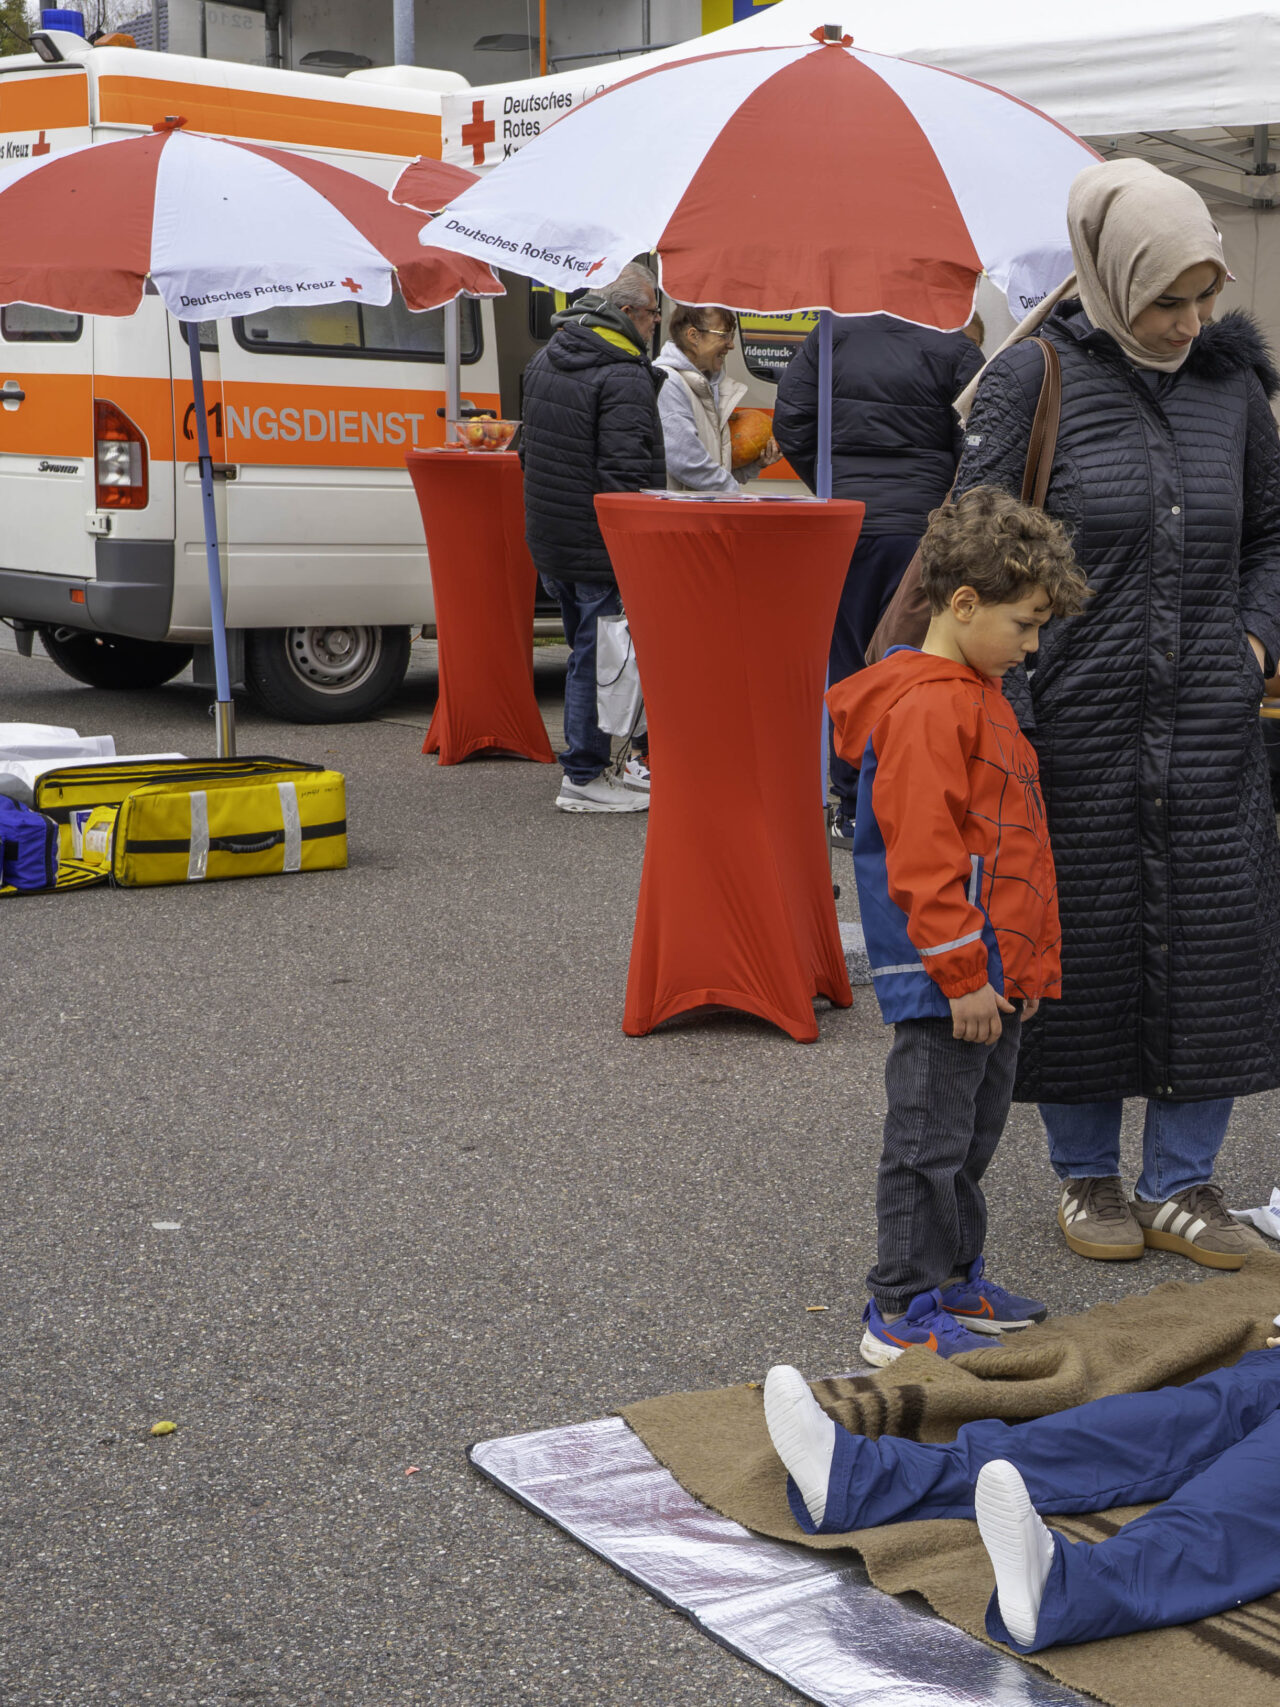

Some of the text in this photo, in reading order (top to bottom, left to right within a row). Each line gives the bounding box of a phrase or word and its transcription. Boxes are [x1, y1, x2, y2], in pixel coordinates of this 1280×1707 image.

[503, 91, 573, 115] Deutsches
[503, 118, 541, 139] Rotes
[6, 141, 30, 159] Kreuz
[444, 219, 519, 253] Deutsches
[520, 242, 562, 265] Rotes
[180, 280, 336, 307] Deutsches Rotes Kreuz
[225, 405, 425, 445] NGSDIENST
